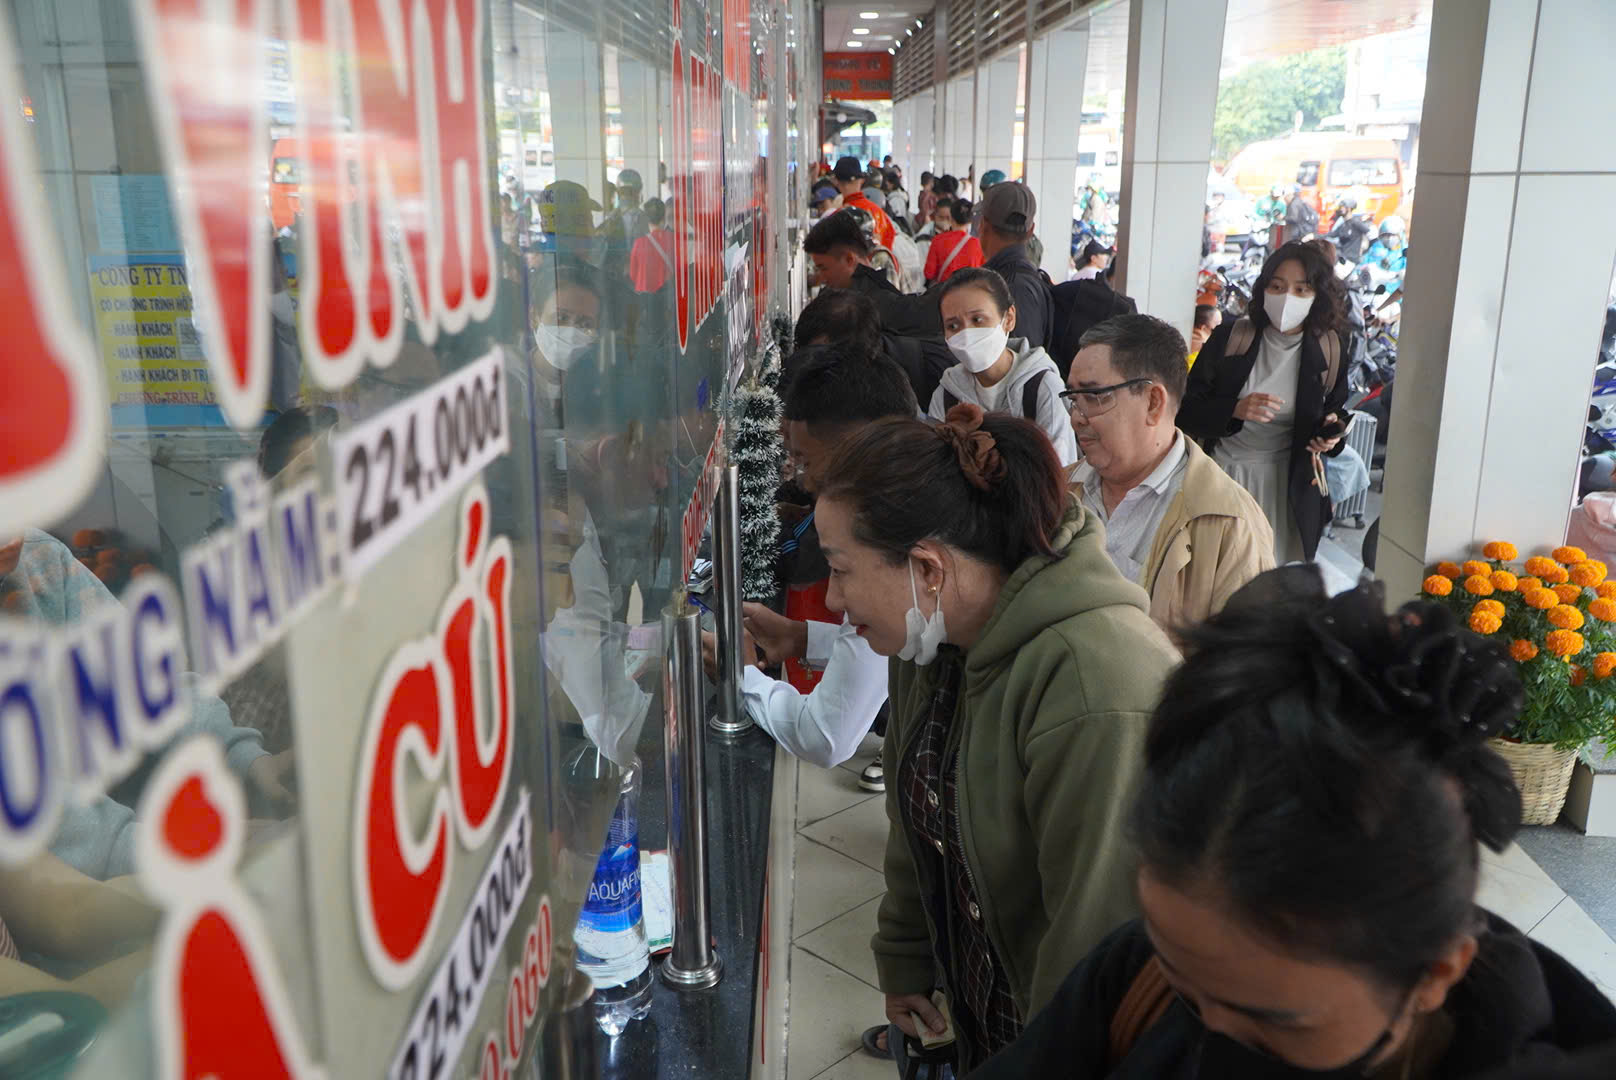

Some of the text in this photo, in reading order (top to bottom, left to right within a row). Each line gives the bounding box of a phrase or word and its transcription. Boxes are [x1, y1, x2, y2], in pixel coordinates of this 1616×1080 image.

[143, 267, 162, 286] TY
[141, 320, 174, 337] KHÁCH
[145, 344, 177, 360] KHÁCH
[148, 367, 179, 382] KHÁCH
[347, 362, 502, 553] 224.000đ
